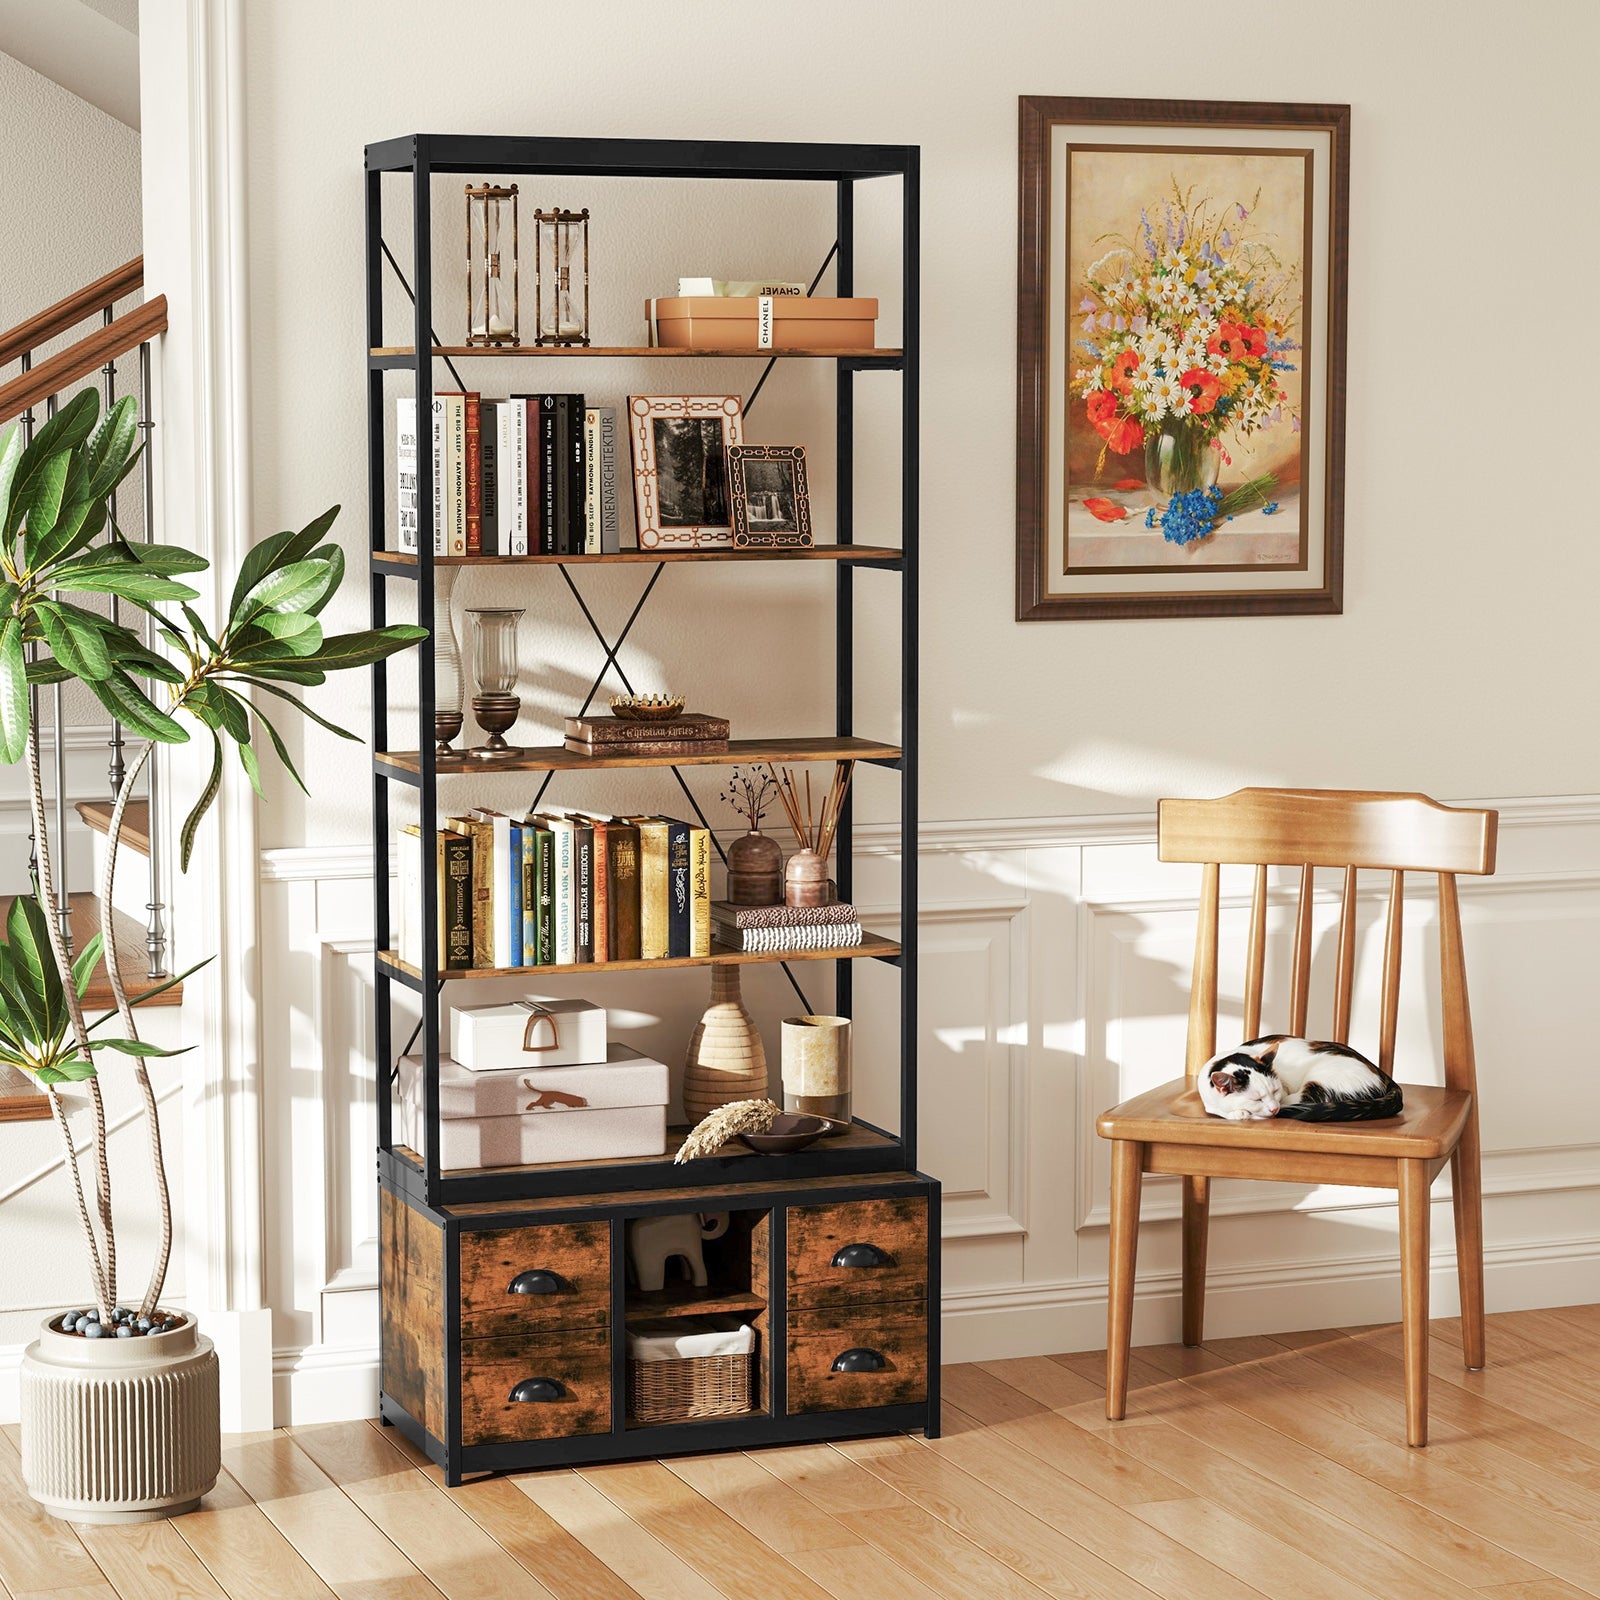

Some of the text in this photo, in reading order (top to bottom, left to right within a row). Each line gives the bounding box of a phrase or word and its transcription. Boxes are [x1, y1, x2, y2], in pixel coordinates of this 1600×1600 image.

[602, 417, 616, 532] INNENARCHITEKTUR
[696, 835, 706, 866] жизни
[561, 874, 569, 899] БЛОК
[694, 867, 707, 899] Жажда
[580, 887, 588, 920] ЛЕСНАЯ
